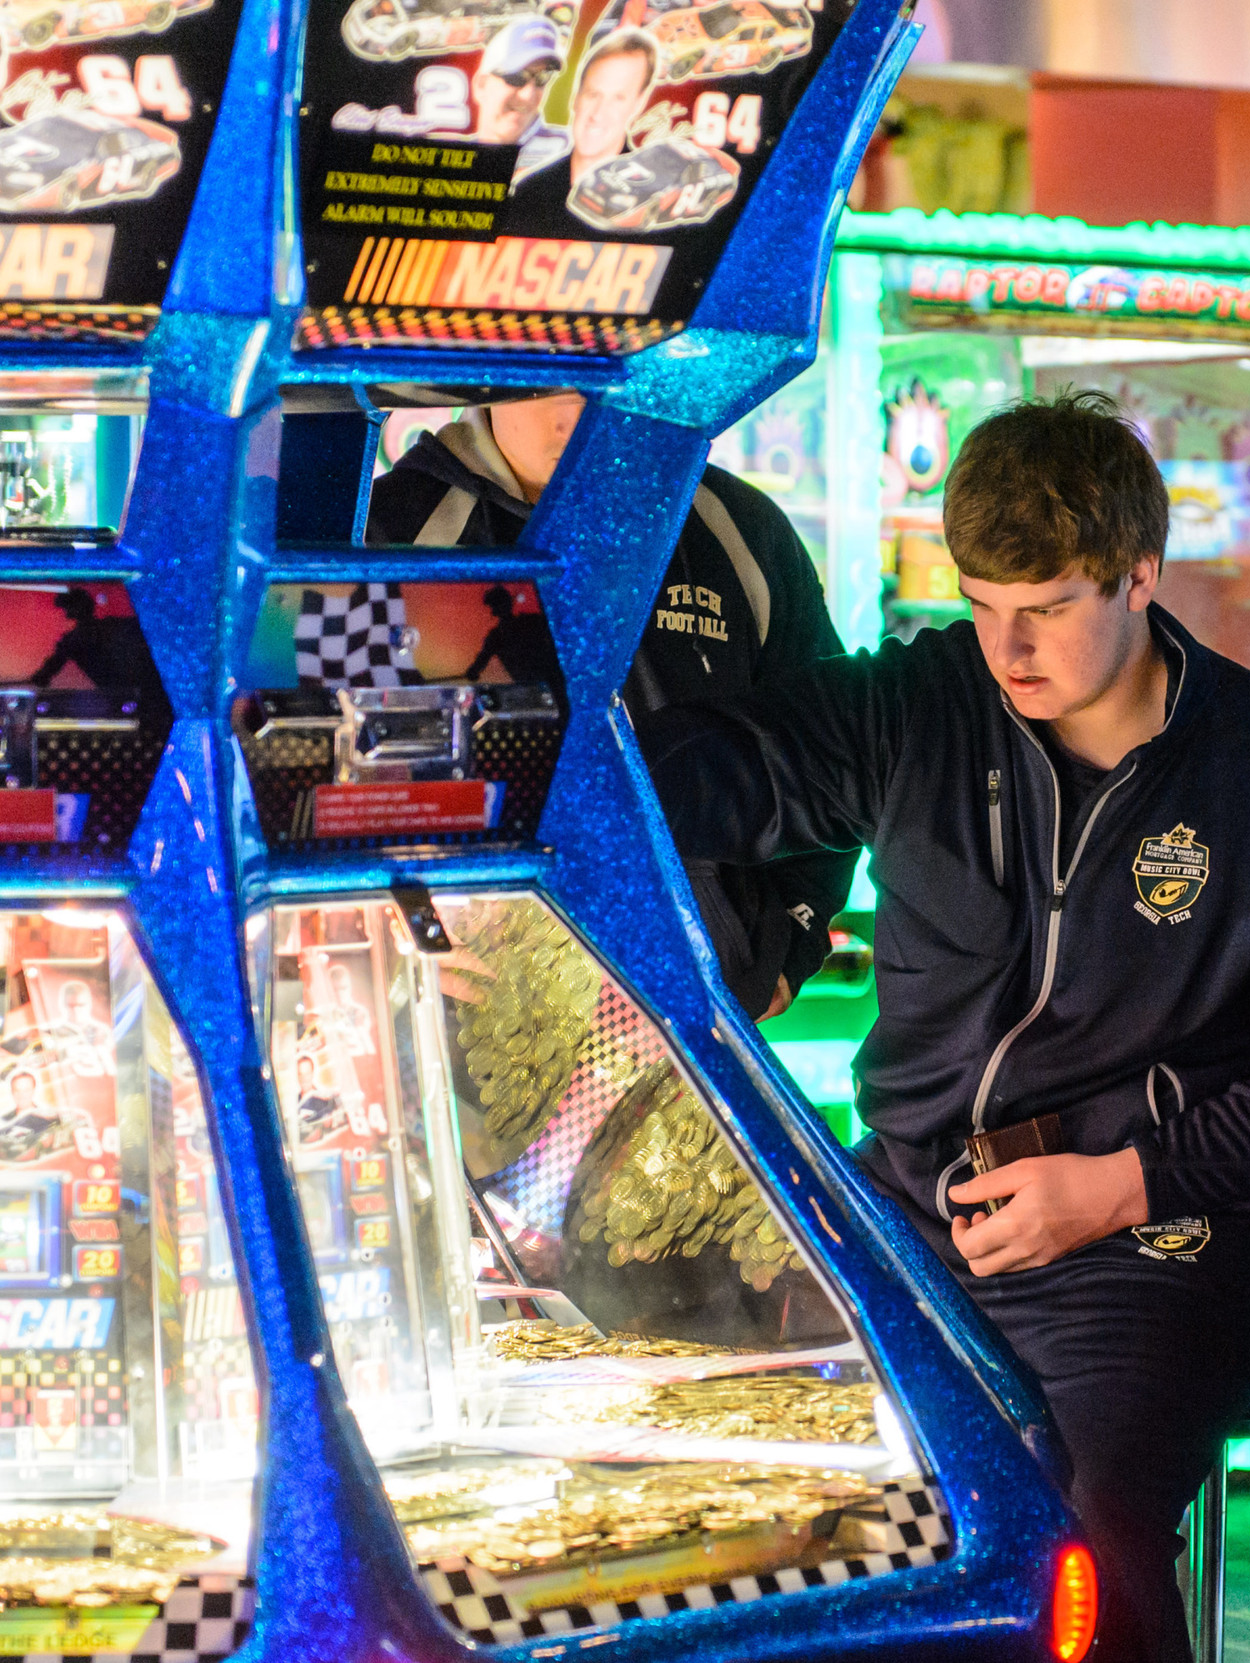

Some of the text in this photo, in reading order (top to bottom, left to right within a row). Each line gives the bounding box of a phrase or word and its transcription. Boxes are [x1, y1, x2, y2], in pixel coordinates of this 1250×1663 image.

[77, 55, 191, 120] 64
[416, 65, 471, 129] 2
[693, 91, 763, 154] 64
[371, 143, 475, 169] DO NOT TILT
[325, 171, 507, 201] EXTREMELY SENSITIVE
[322, 202, 385, 224] ALARM
[387, 206, 426, 227] WILL
[0, 223, 95, 299] AR
[443, 238, 658, 315] NASCAR
[909, 265, 1070, 308] RAPTOR
[667, 584, 722, 617] TECH
[1172, 848, 1204, 859] American
[1140, 864, 1201, 877] MUSIC CITY BOWL
[1167, 909, 1192, 925] TECH
[360, 1161, 380, 1178] 10
[86, 1185, 113, 1205] 10
[363, 1223, 387, 1240] 20
[83, 1250, 115, 1268] 20
